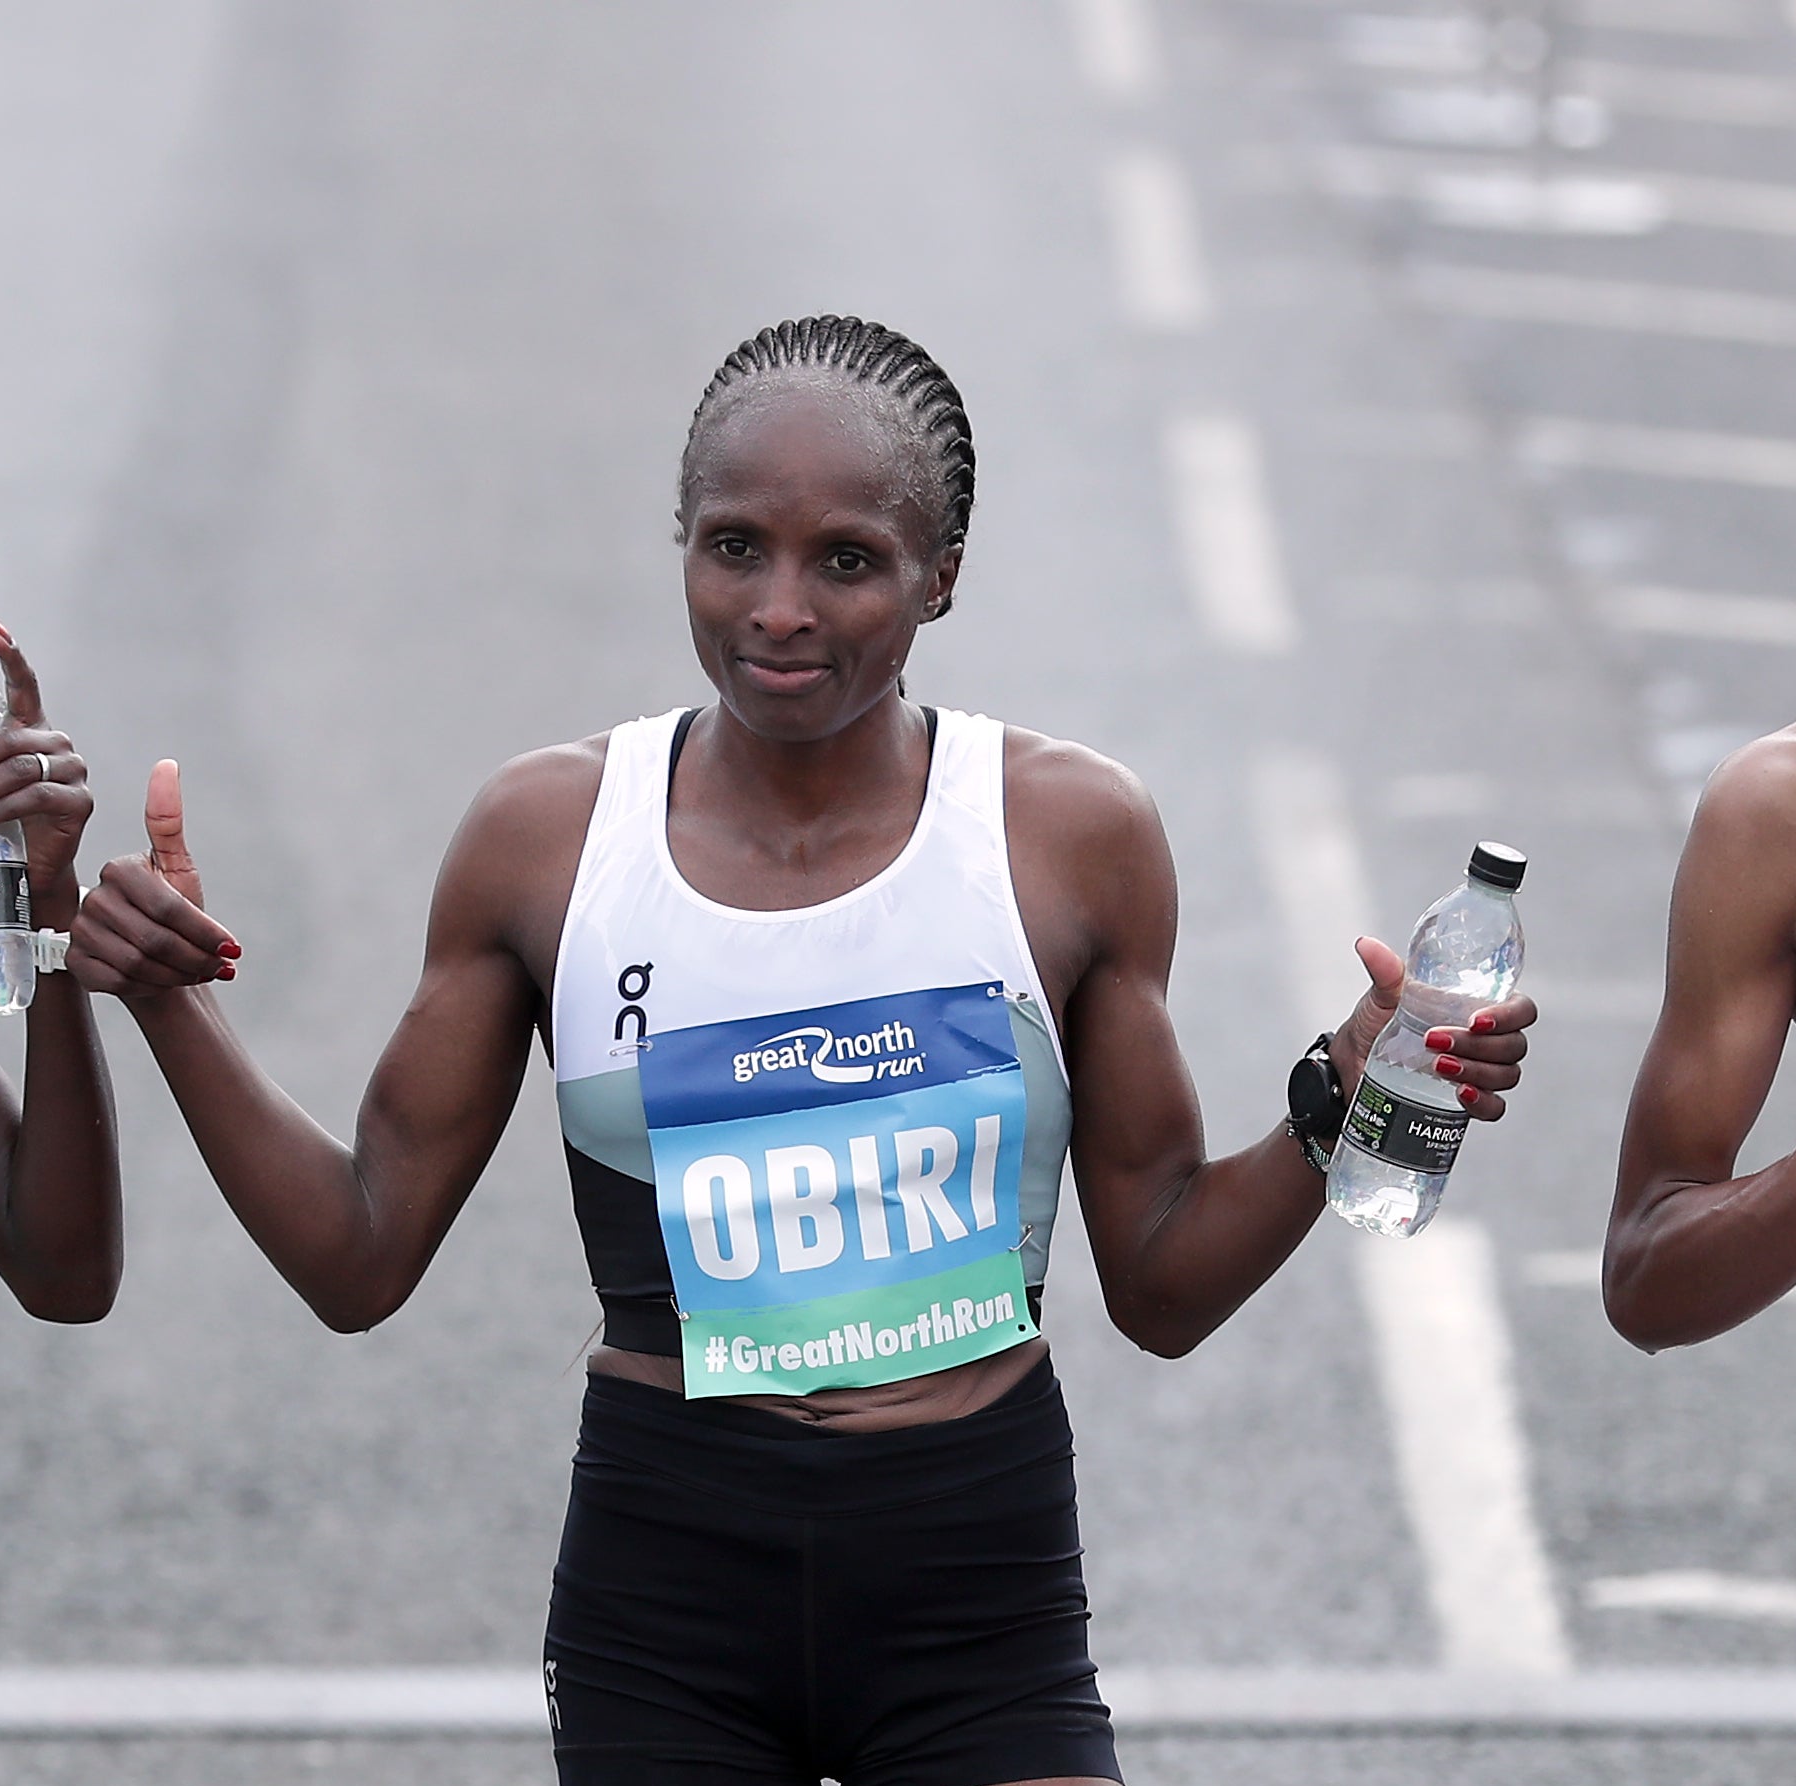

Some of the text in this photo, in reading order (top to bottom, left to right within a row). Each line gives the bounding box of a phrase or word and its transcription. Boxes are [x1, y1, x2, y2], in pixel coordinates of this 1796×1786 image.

[733, 1020, 916, 1082] great north
[876, 1055, 924, 1080] run
[681, 1114, 1002, 1282] OBIRI
[704, 1286, 1015, 1375] #GreatNorthRun
